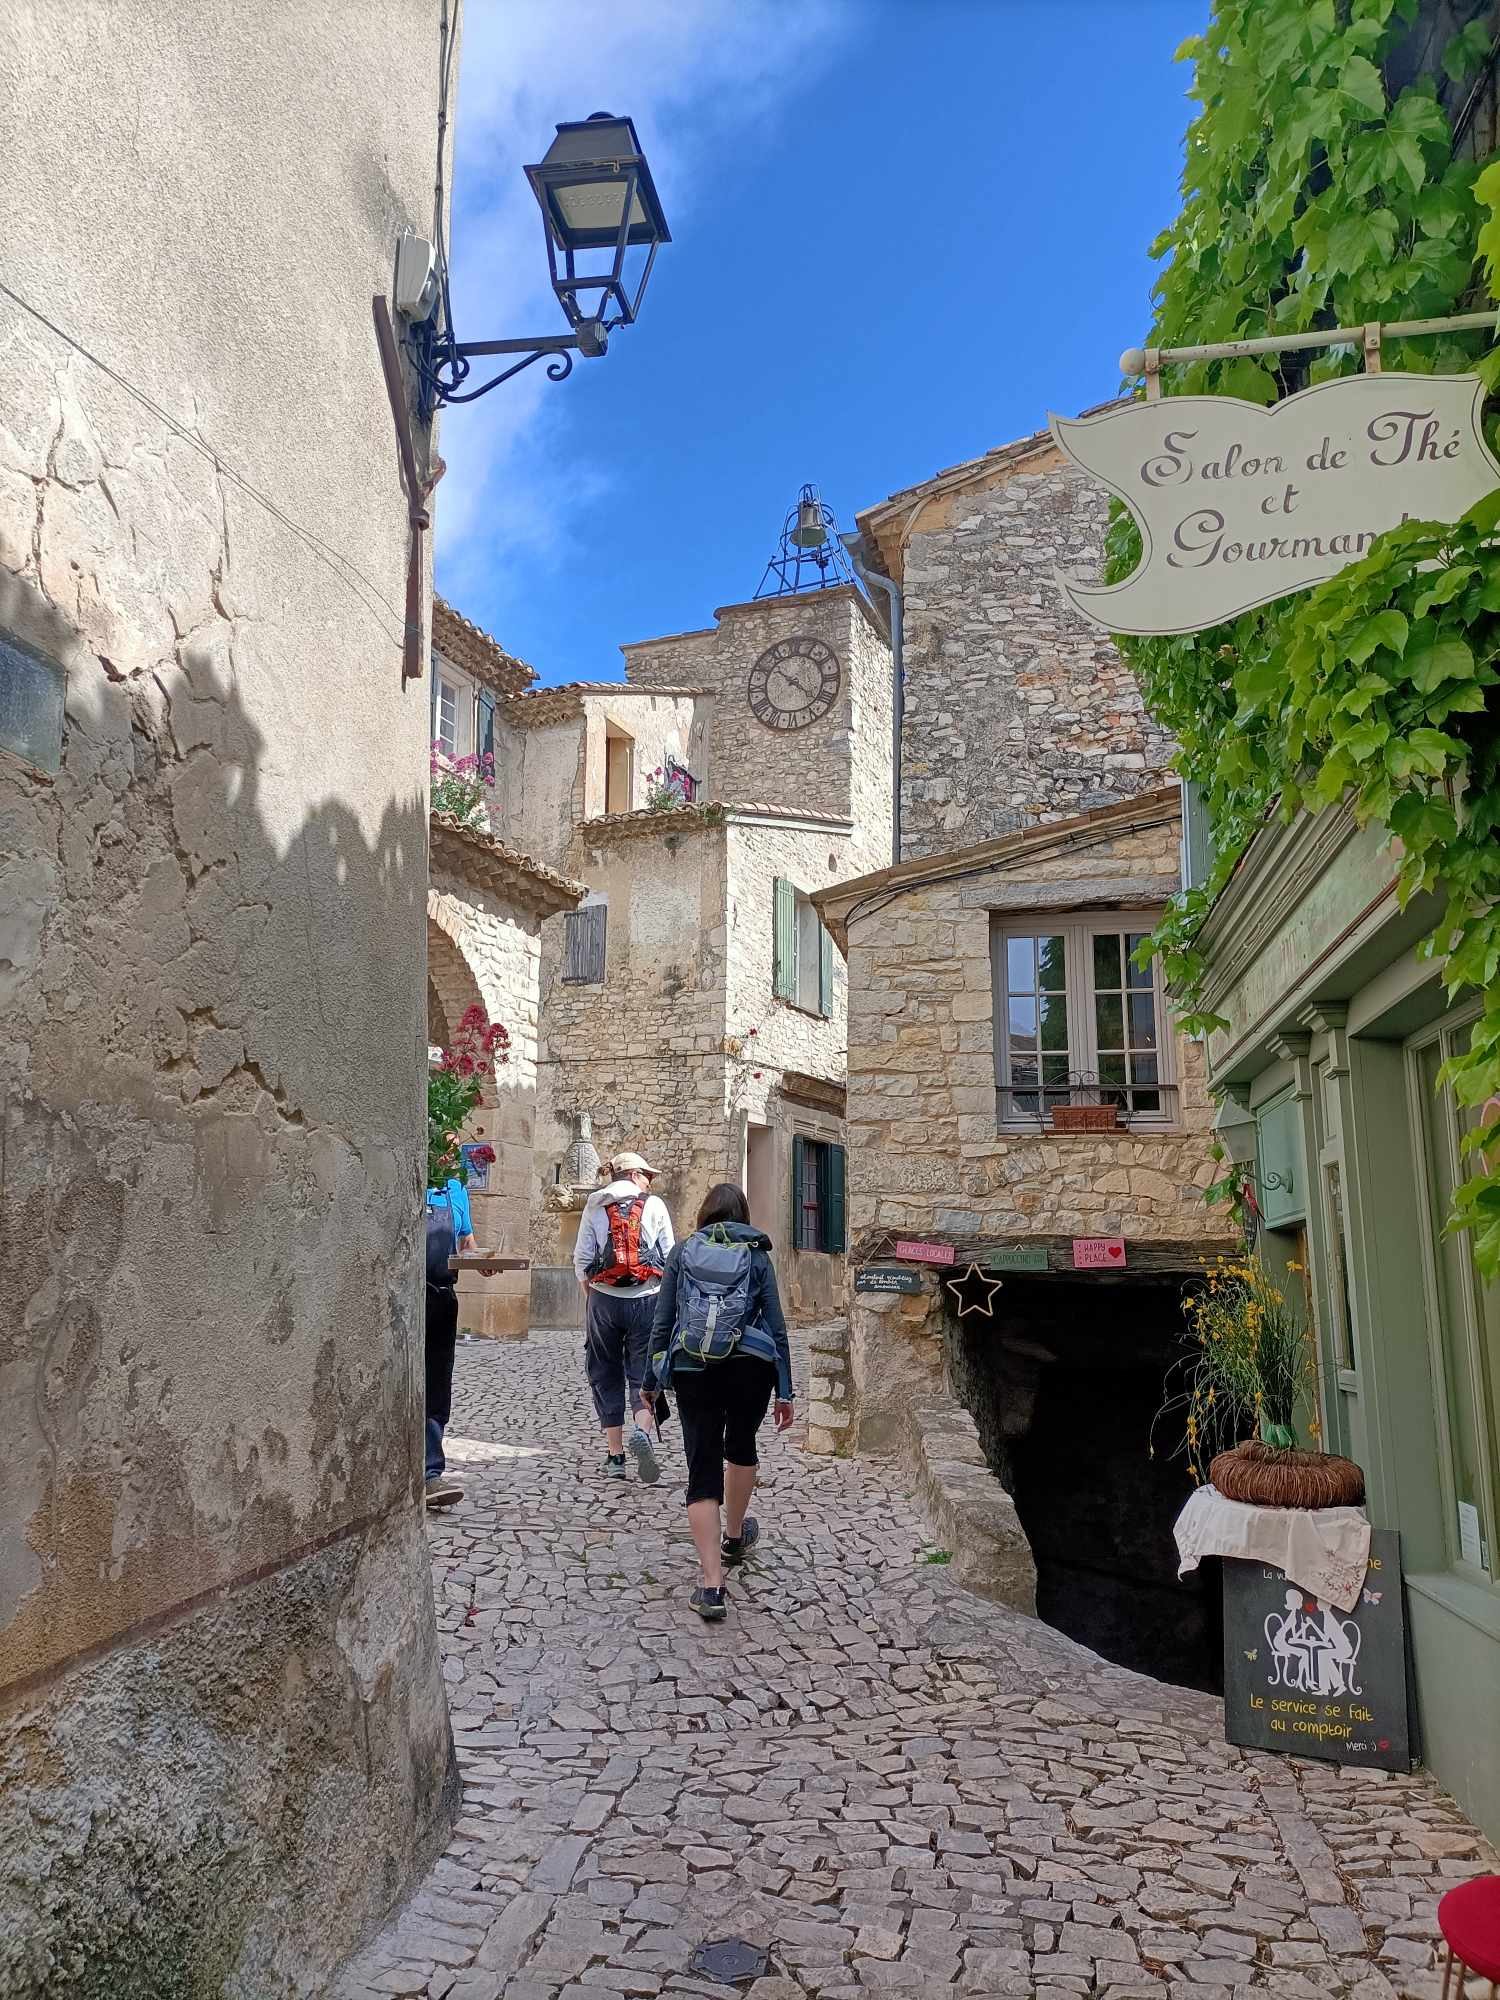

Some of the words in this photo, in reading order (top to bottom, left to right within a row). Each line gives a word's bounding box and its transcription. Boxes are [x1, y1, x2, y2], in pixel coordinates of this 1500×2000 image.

[1140, 430, 1288, 487] Salon
[1306, 436, 1348, 472] de
[1367, 408, 1461, 466] Thé
[1260, 484, 1300, 515] et
[1084, 1243, 1105, 1253] HAPPY
[1084, 1253, 1106, 1263] PLACE
[1263, 1568, 1273, 1580] La
[1250, 1692, 1264, 1709] Le
[1271, 1699, 1317, 1715] service
[1324, 1704, 1341, 1717] se
[1349, 1704, 1374, 1722] fait
[1270, 1719, 1286, 1732] au
[1292, 1719, 1353, 1741] comptoir
[1346, 1740, 1367, 1752] Merci
